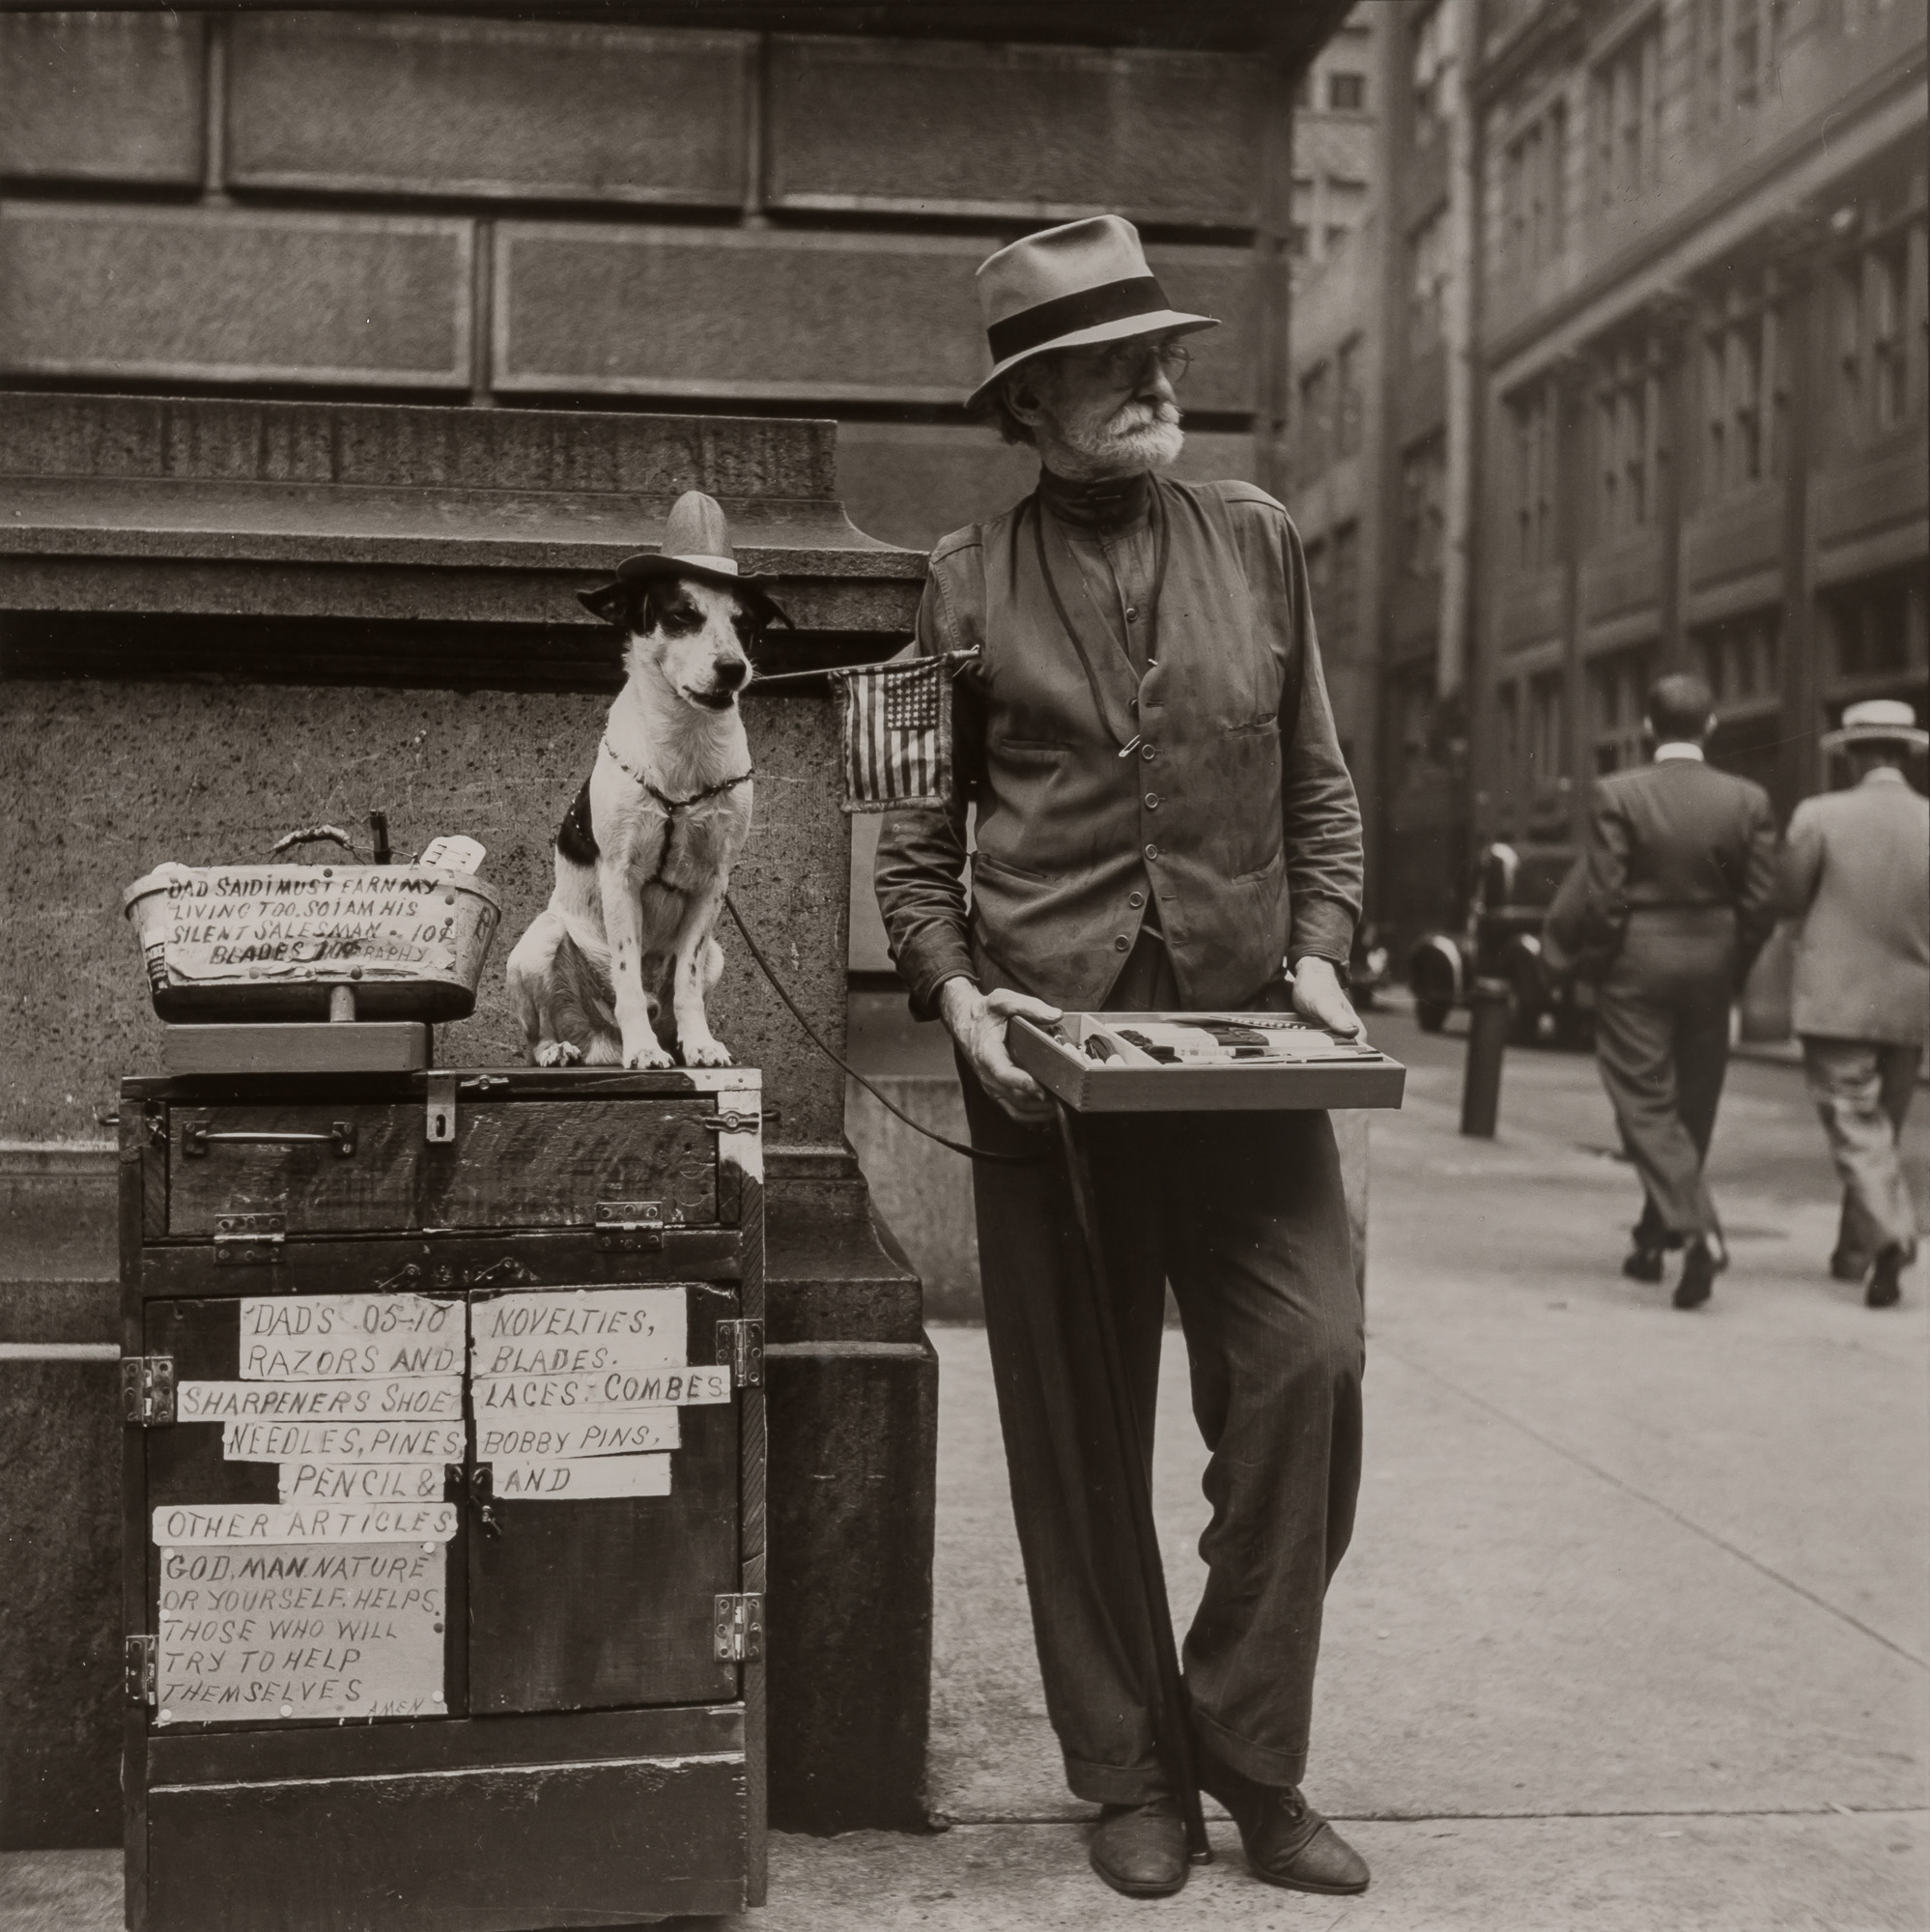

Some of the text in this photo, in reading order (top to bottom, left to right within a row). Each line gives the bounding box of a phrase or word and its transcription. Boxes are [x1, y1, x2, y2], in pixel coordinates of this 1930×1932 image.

[214, 876, 263, 897] SAID
[275, 878, 333, 895] MUST
[341, 876, 397, 895] EARN
[400, 878, 440, 895] MY
[174, 902, 251, 920] LIVING
[303, 899, 329, 917] SO
[343, 899, 374, 917] AM
[168, 924, 251, 944] SILENT
[254, 920, 383, 940] SALESMAN
[491, 1306, 655, 1338] NOVELTIES,
[248, 1345, 379, 1377] RAZORS
[389, 1346, 454, 1373] AND
[183, 1385, 370, 1415] SHARPENERS
[381, 1382, 451, 1412] SHOE
[604, 1373, 723, 1403] COMBES
[483, 1431, 571, 1454] BOBBY
[293, 1464, 571, 1496] PENCIL & AND
[167, 1509, 451, 1538] OTHER ARTICLES
[311, 1556, 429, 1582] NATURE
[163, 1589, 199, 1611] OR
[163, 1618, 397, 1643] THOSE WHO WILL
[165, 1648, 361, 1674] TRY TO HELP
[162, 1679, 362, 1704] THEMSELVES
